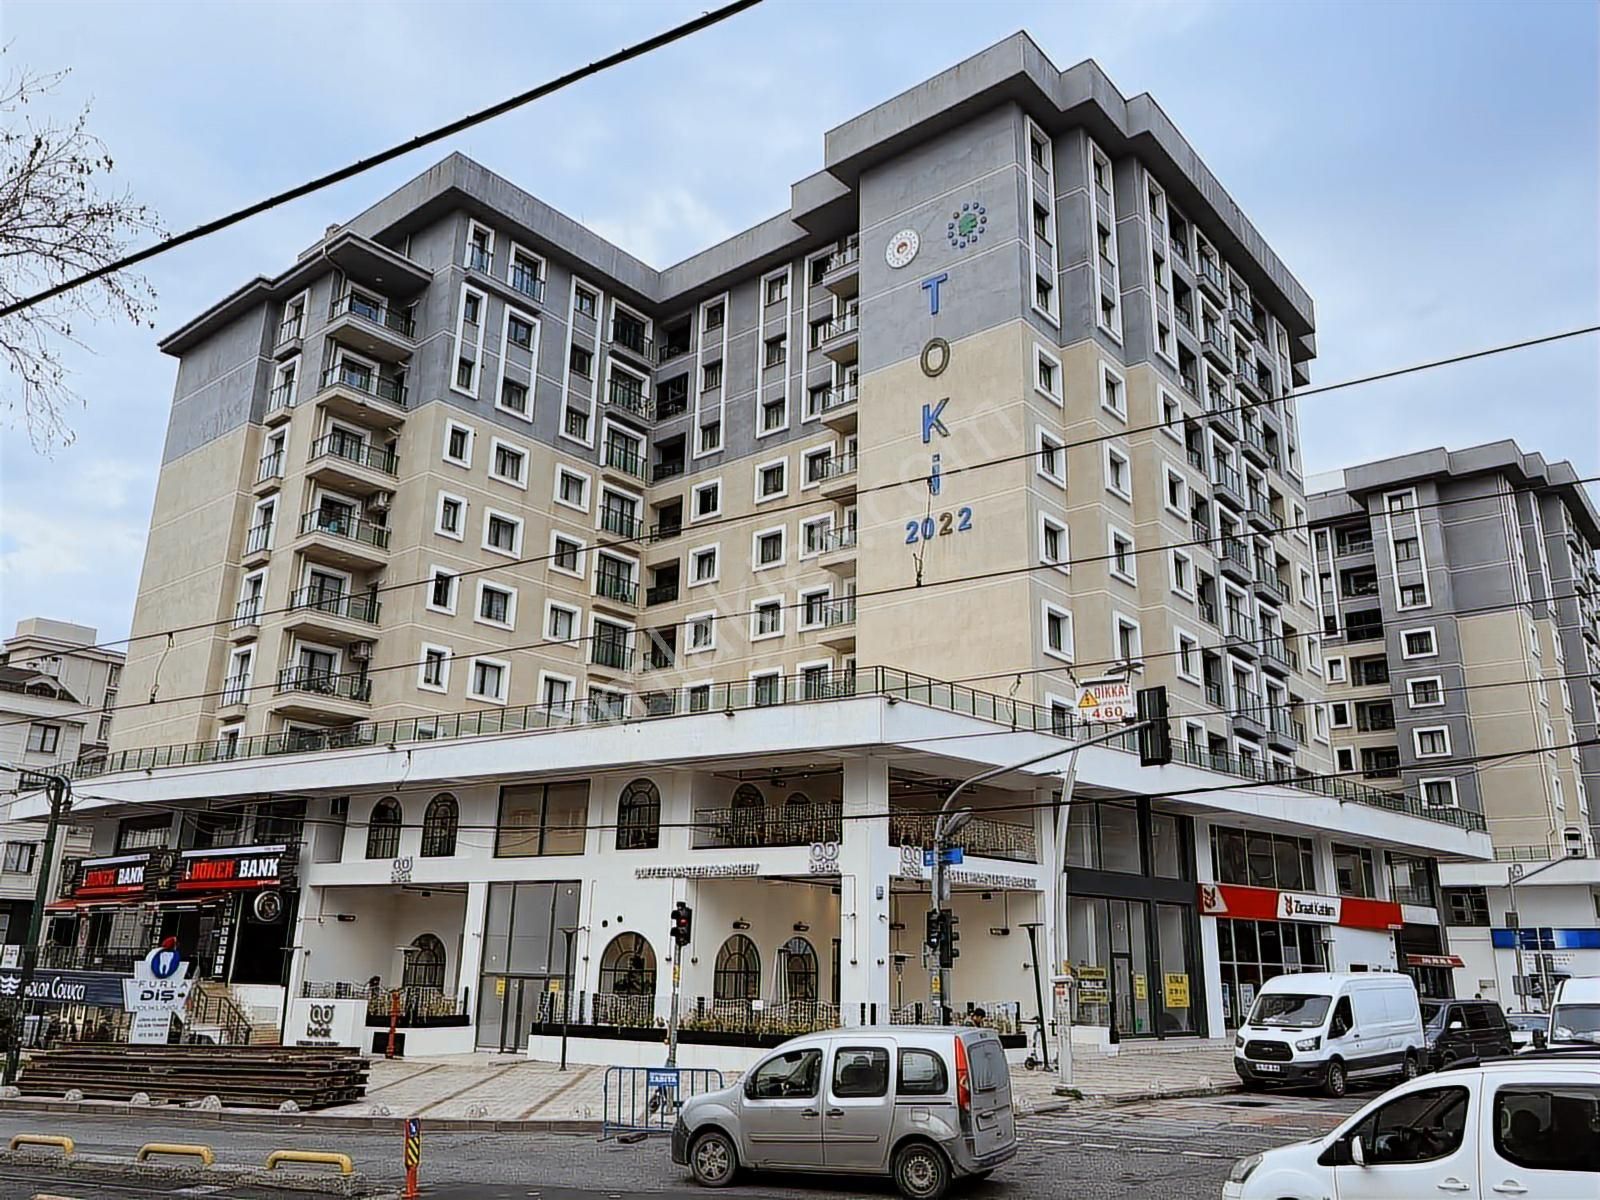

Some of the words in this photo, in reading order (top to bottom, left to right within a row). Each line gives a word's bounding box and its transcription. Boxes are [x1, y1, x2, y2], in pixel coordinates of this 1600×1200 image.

[904, 506, 973, 545] 2022
[117, 866, 145, 885] BANK
[237, 858, 280, 878] BANK
[139, 980, 188, 989] FURLA
